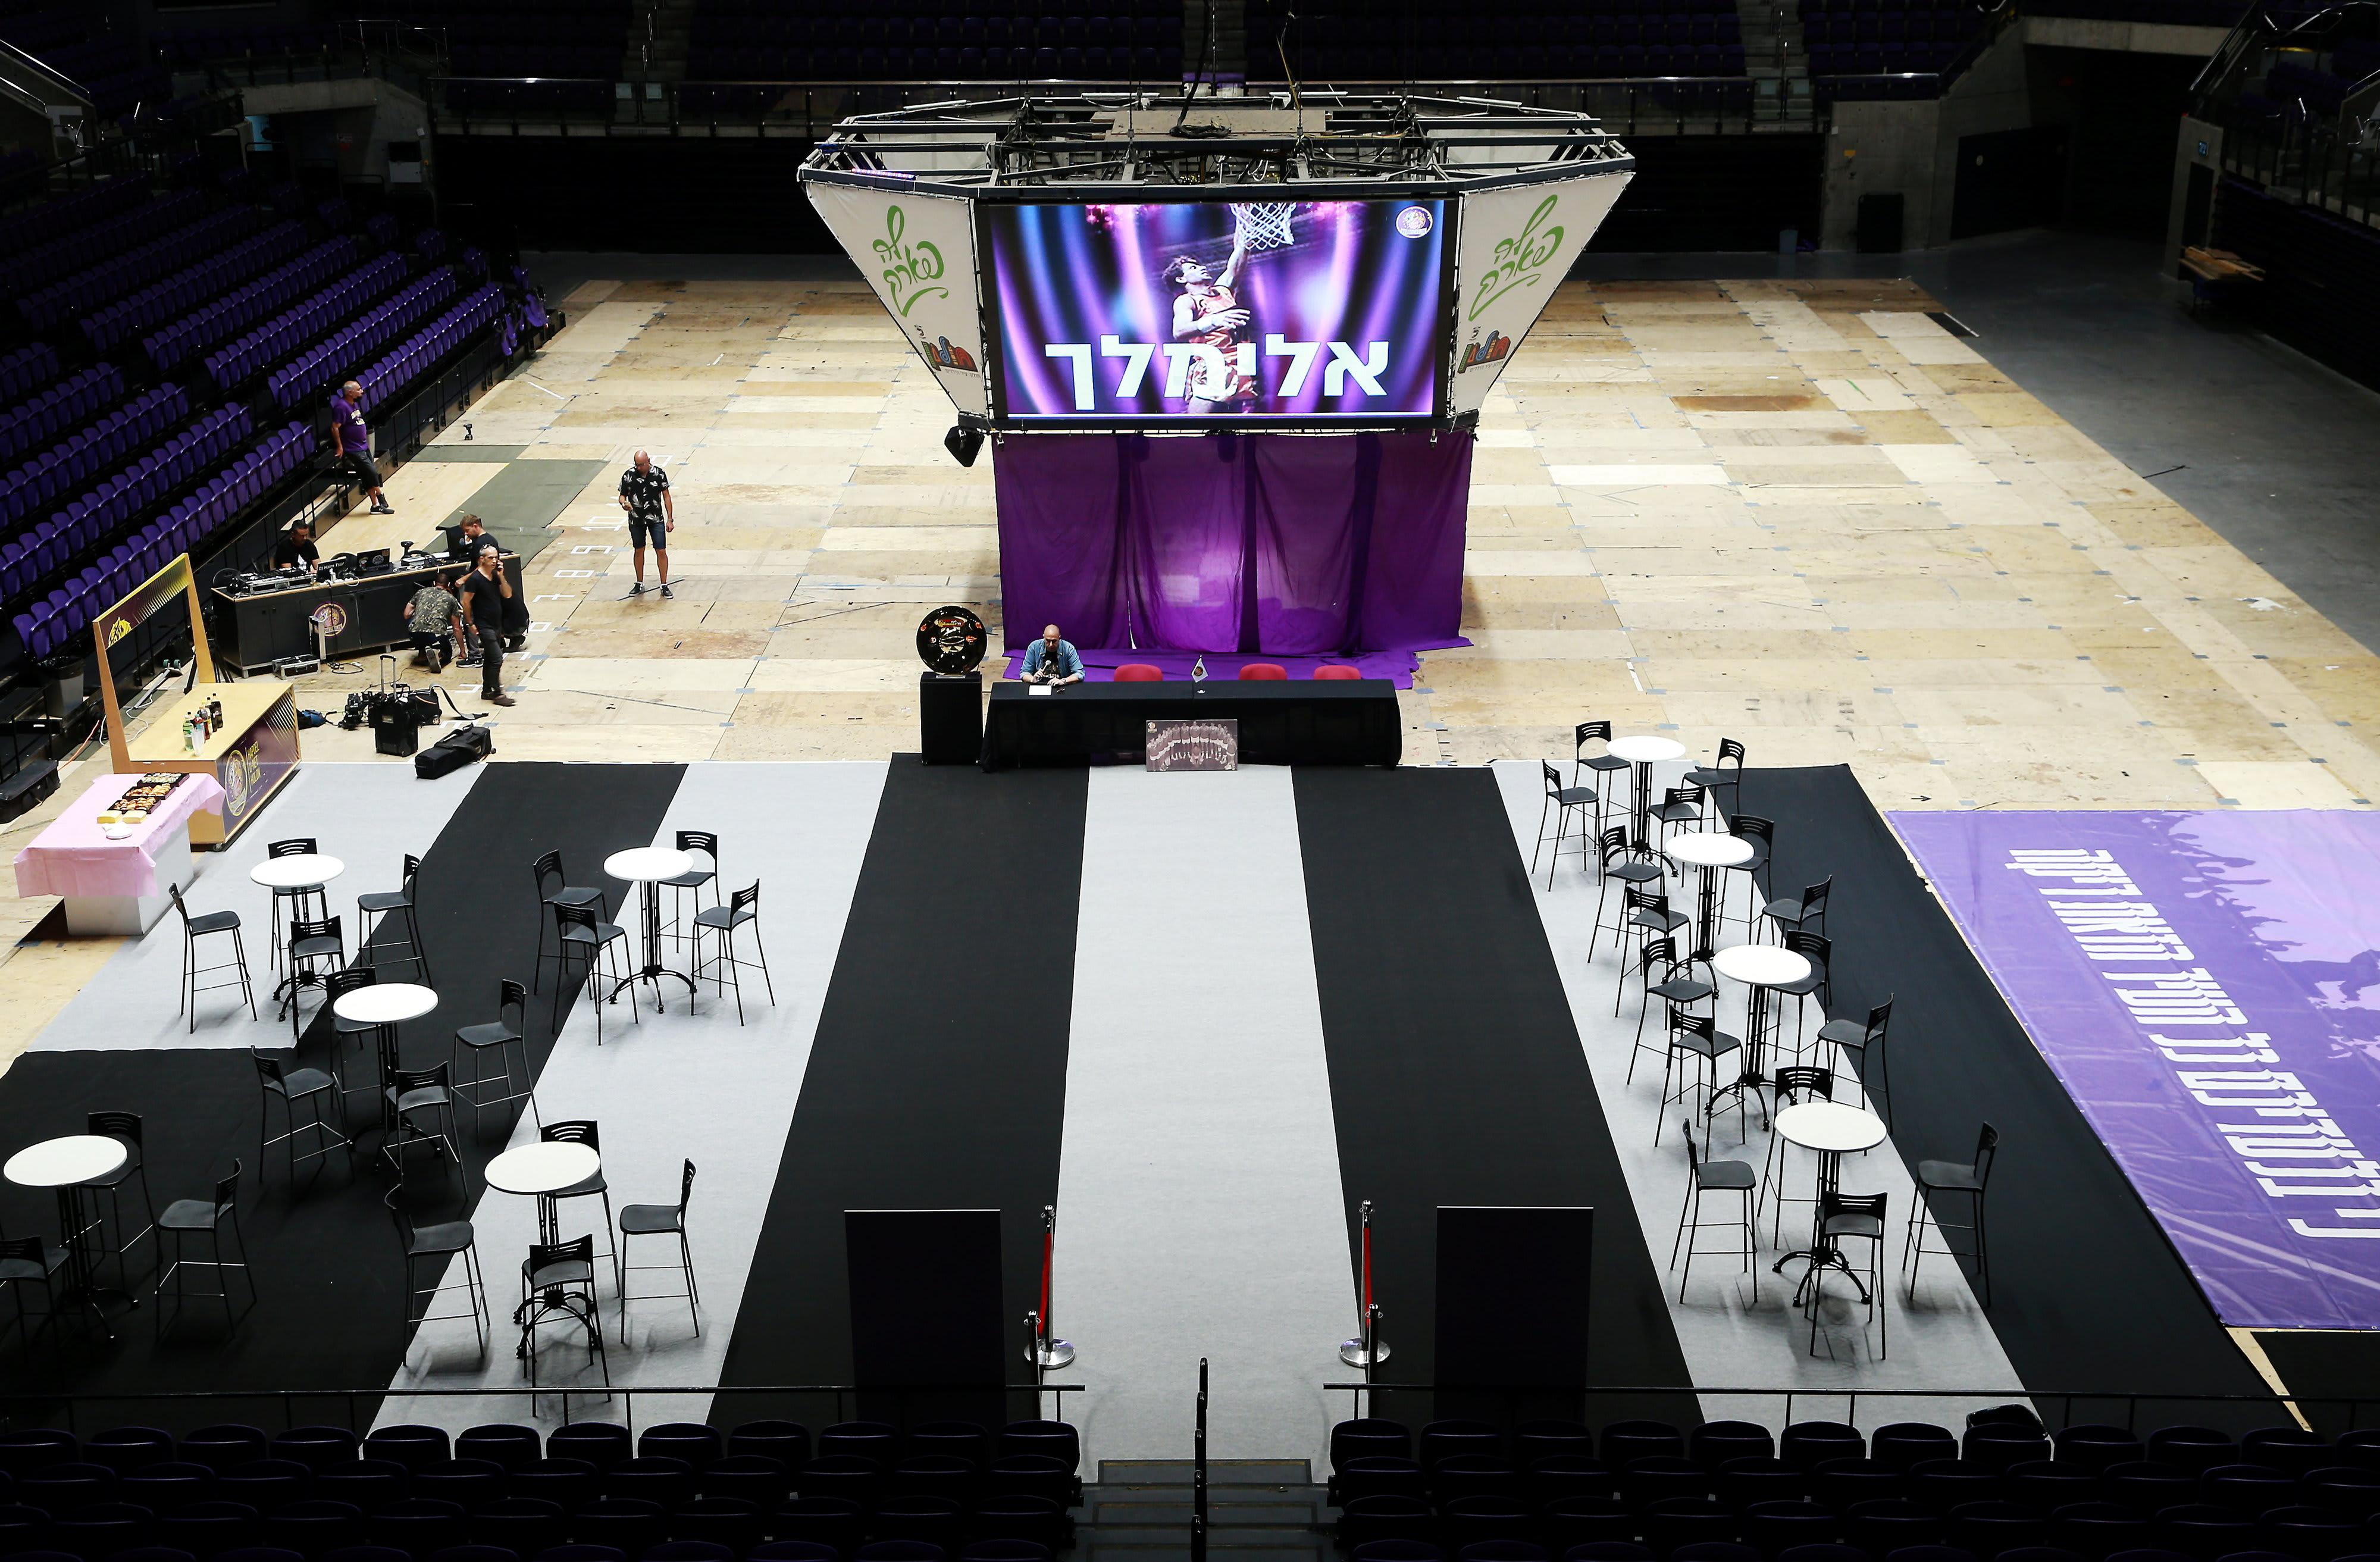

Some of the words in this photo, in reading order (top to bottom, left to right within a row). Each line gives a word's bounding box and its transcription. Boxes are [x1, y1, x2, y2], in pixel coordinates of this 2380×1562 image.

[1045, 333, 1389, 411] אלימלך
[2004, 848, 2143, 896] ריקה
[2047, 900, 2196, 961] הזאת
[2102, 968, 2249, 1025] העיר
[2148, 1032, 2281, 1064] כל
